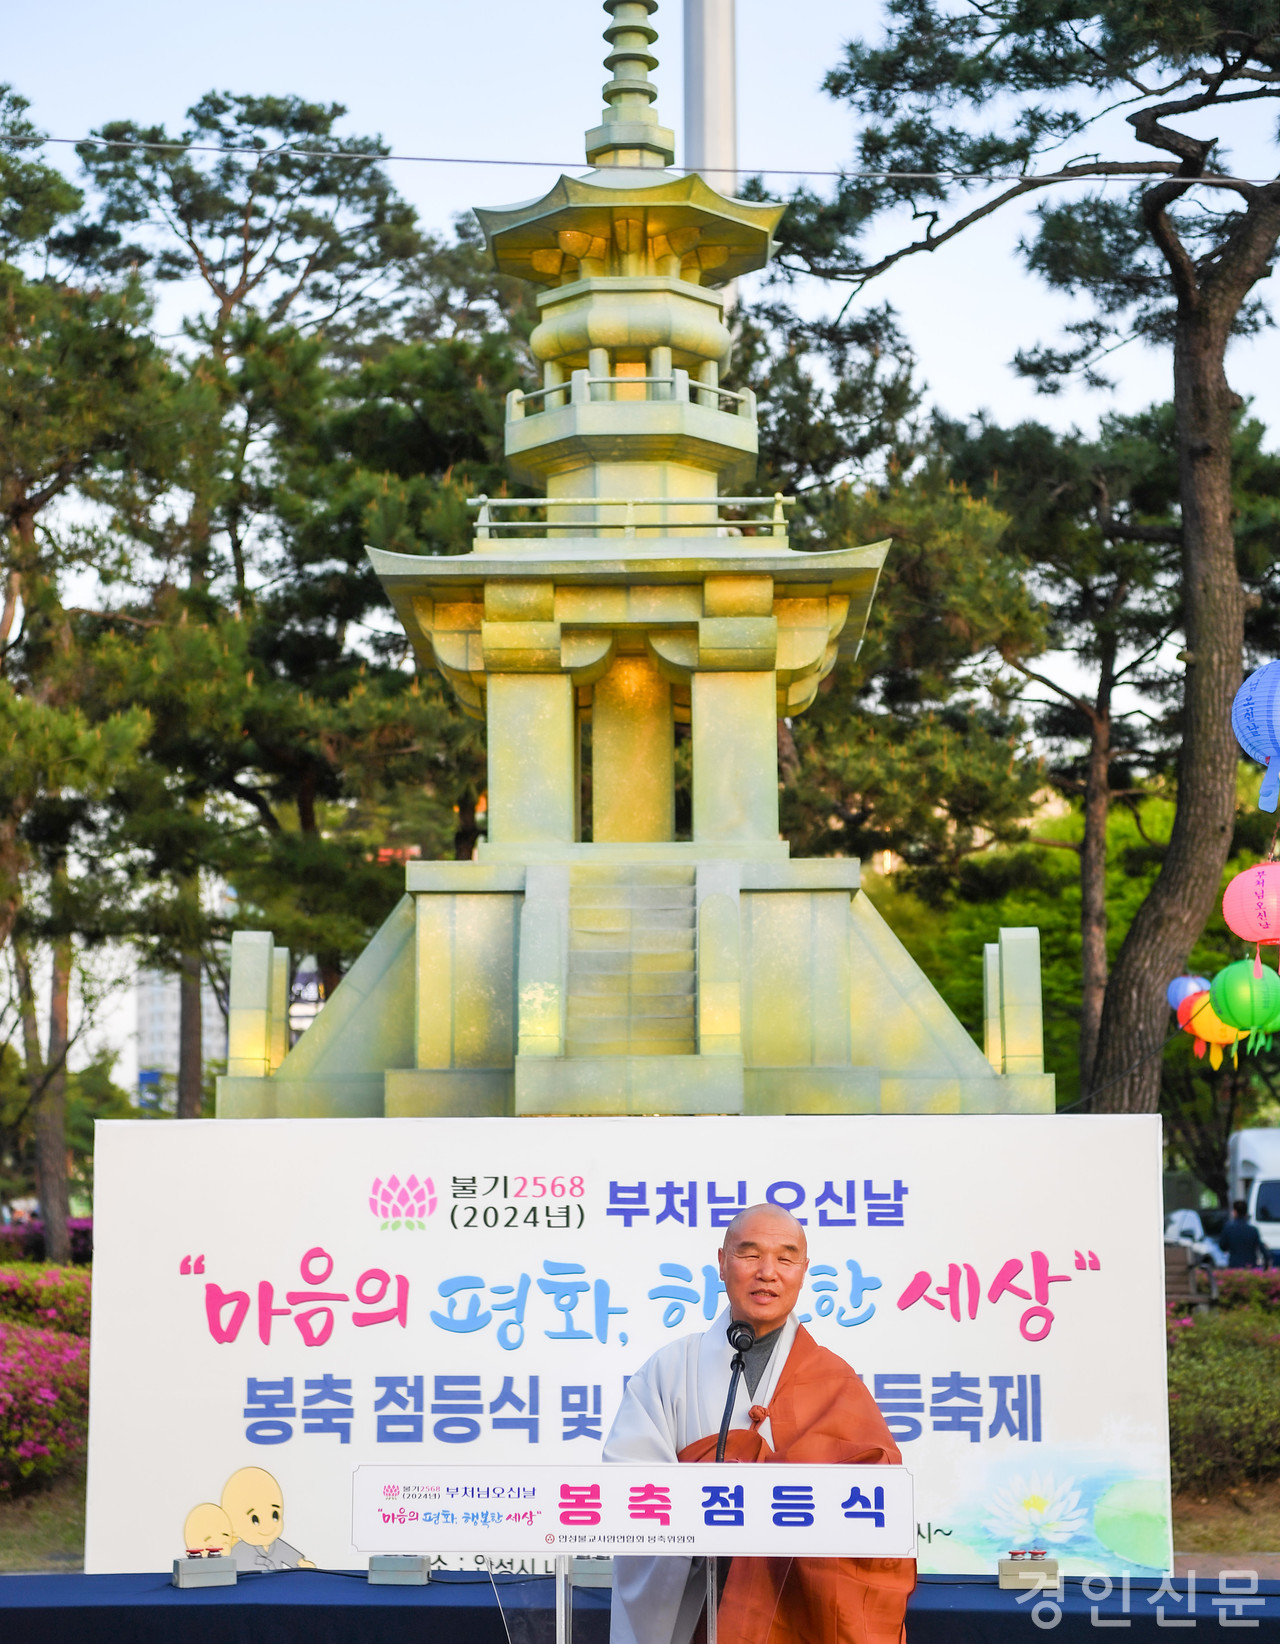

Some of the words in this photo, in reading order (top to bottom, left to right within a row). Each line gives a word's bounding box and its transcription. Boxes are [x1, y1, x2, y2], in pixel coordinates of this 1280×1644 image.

[451, 1176, 585, 1199] 불기2568
[450, 1203, 586, 1230] (2024년)
[606, 1180, 747, 1228] 부처님
[765, 1180, 909, 1228] 오신날
[430, 1259, 629, 1351] 평화,
[244, 1374, 354, 1446] 봉축
[374, 1375, 540, 1444] 점등식
[562, 1385, 603, 1441] 및
[855, 1371, 1043, 1443] 등축제
[446, 1486, 536, 1500] 부처님오신날
[461, 1510, 503, 1529] 행복한
